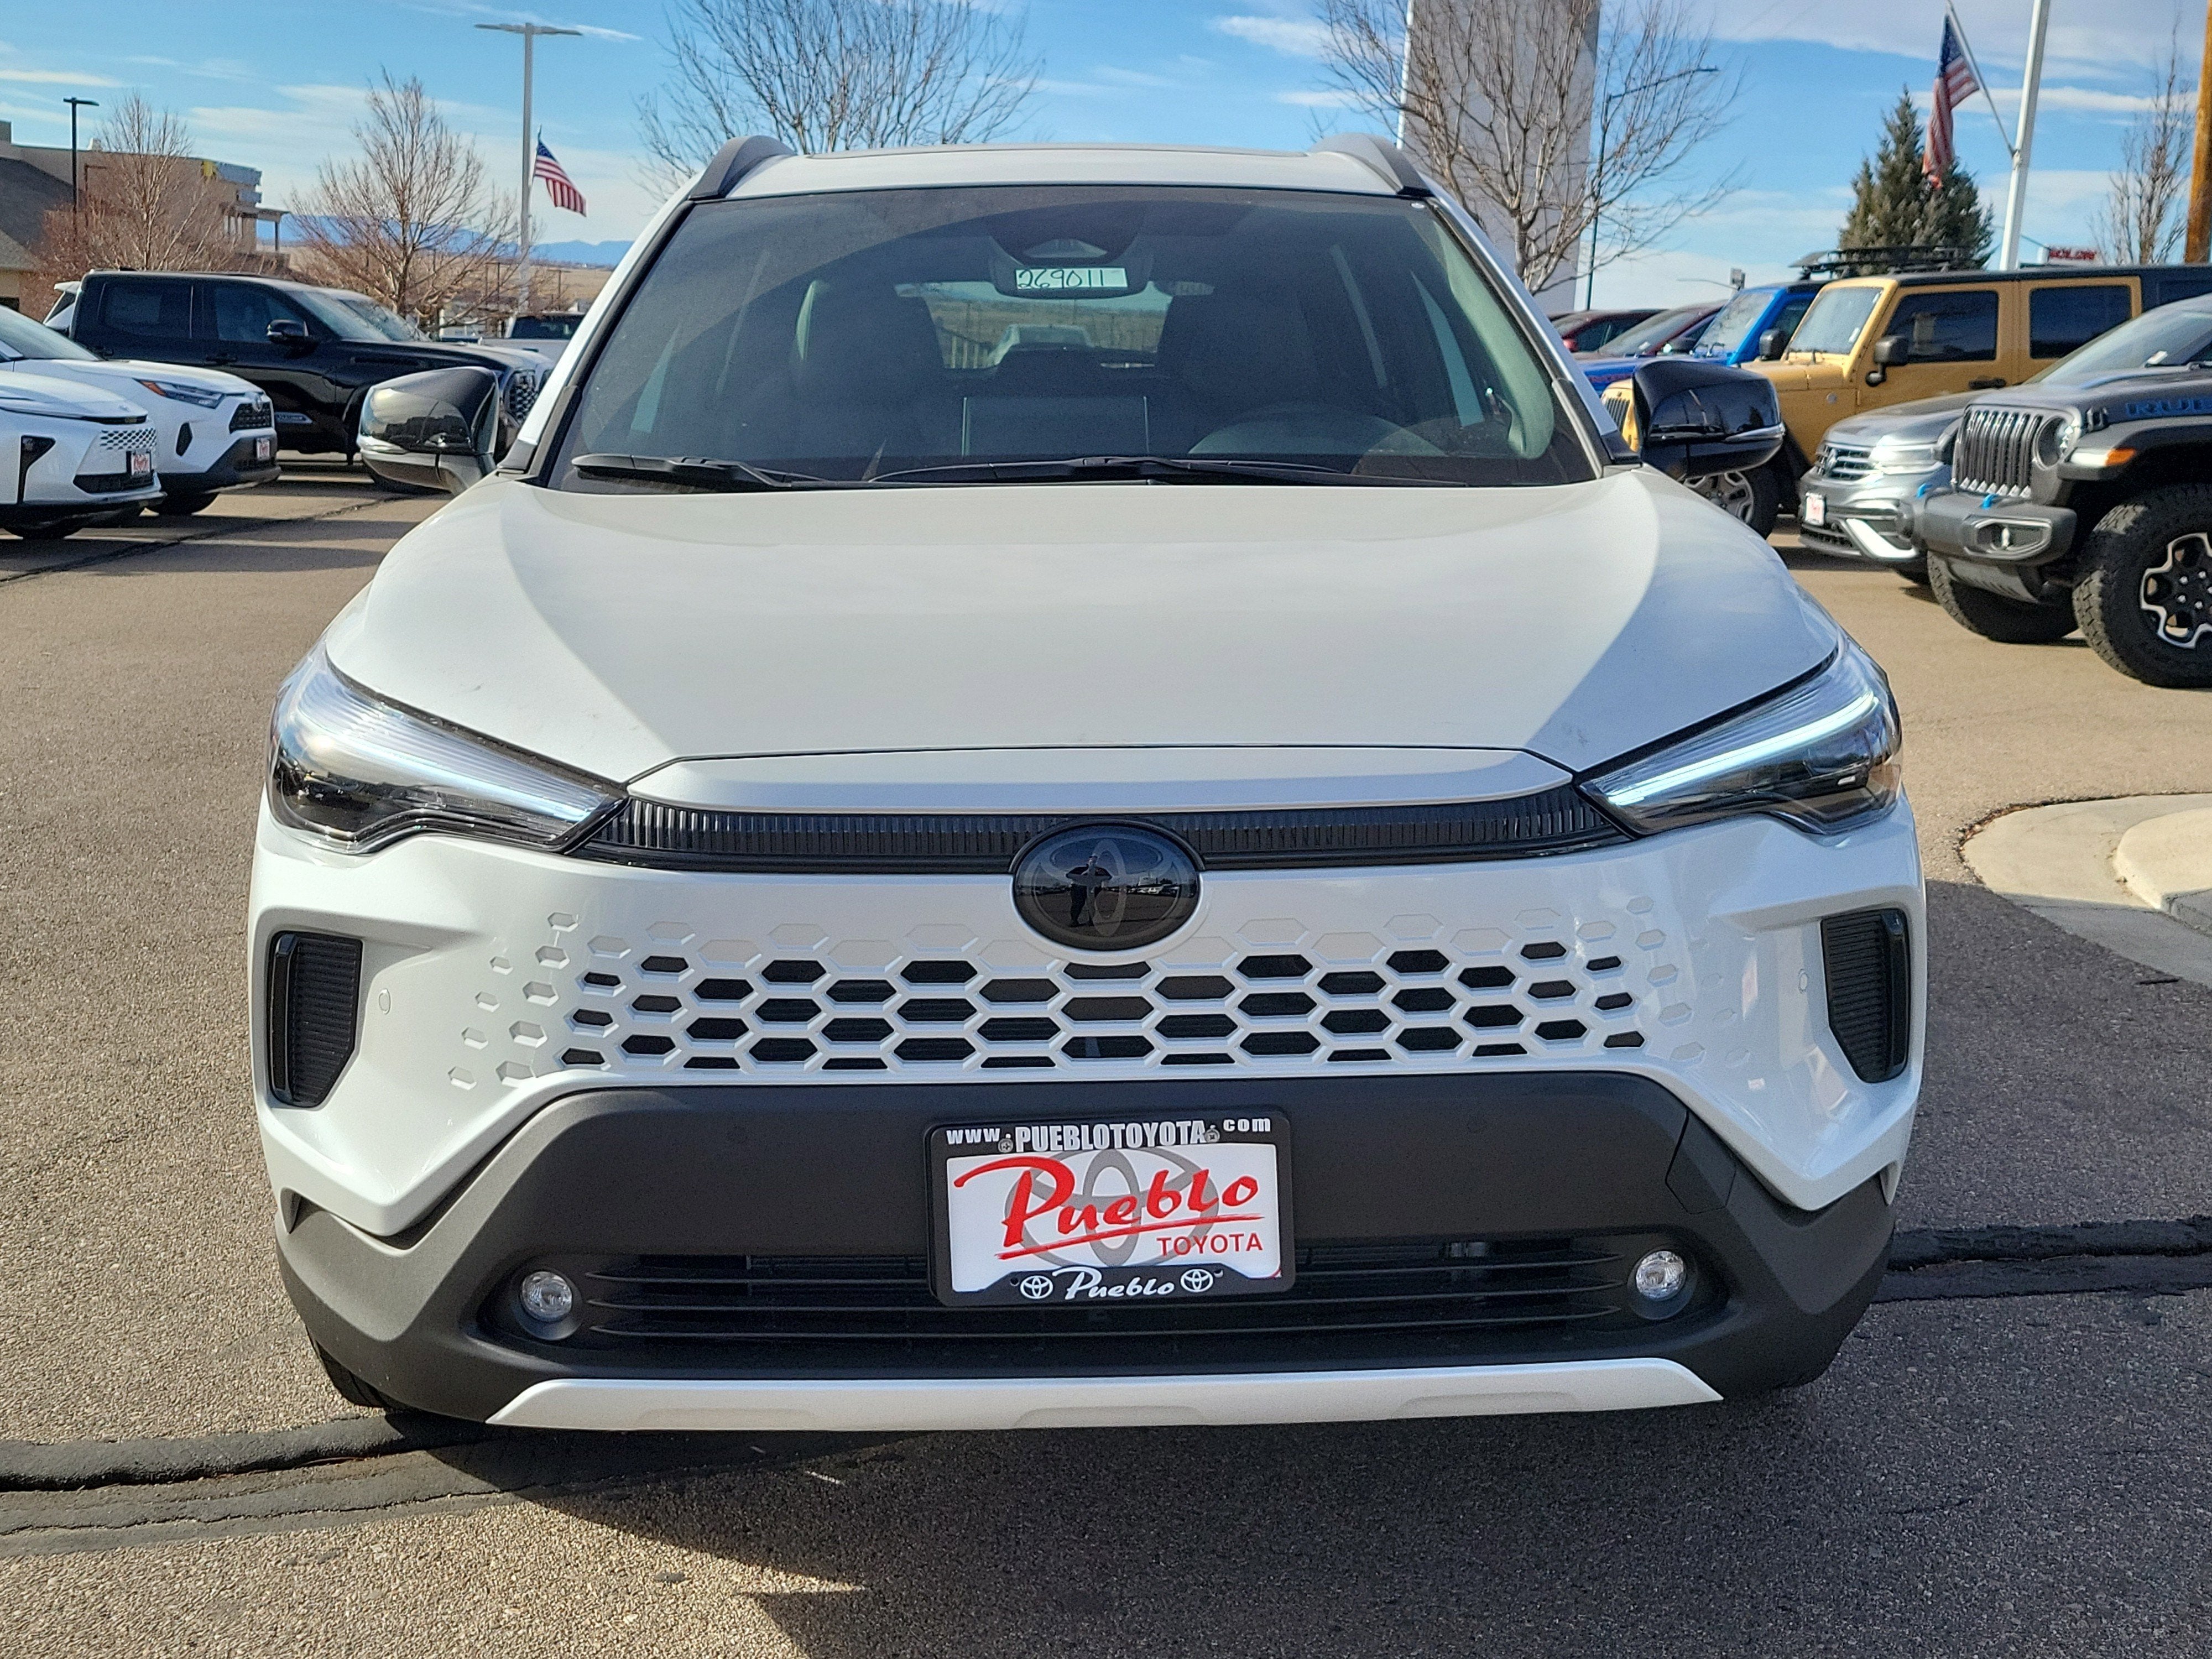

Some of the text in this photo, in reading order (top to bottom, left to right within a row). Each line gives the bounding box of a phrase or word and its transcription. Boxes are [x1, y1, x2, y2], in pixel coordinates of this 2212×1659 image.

[1018, 269, 1104, 289] 269011
[953, 1156, 1258, 1248] Pueblo
[1156, 1233, 1263, 1256] TOYOTA
[1052, 1266, 1175, 1300] Pueblo
